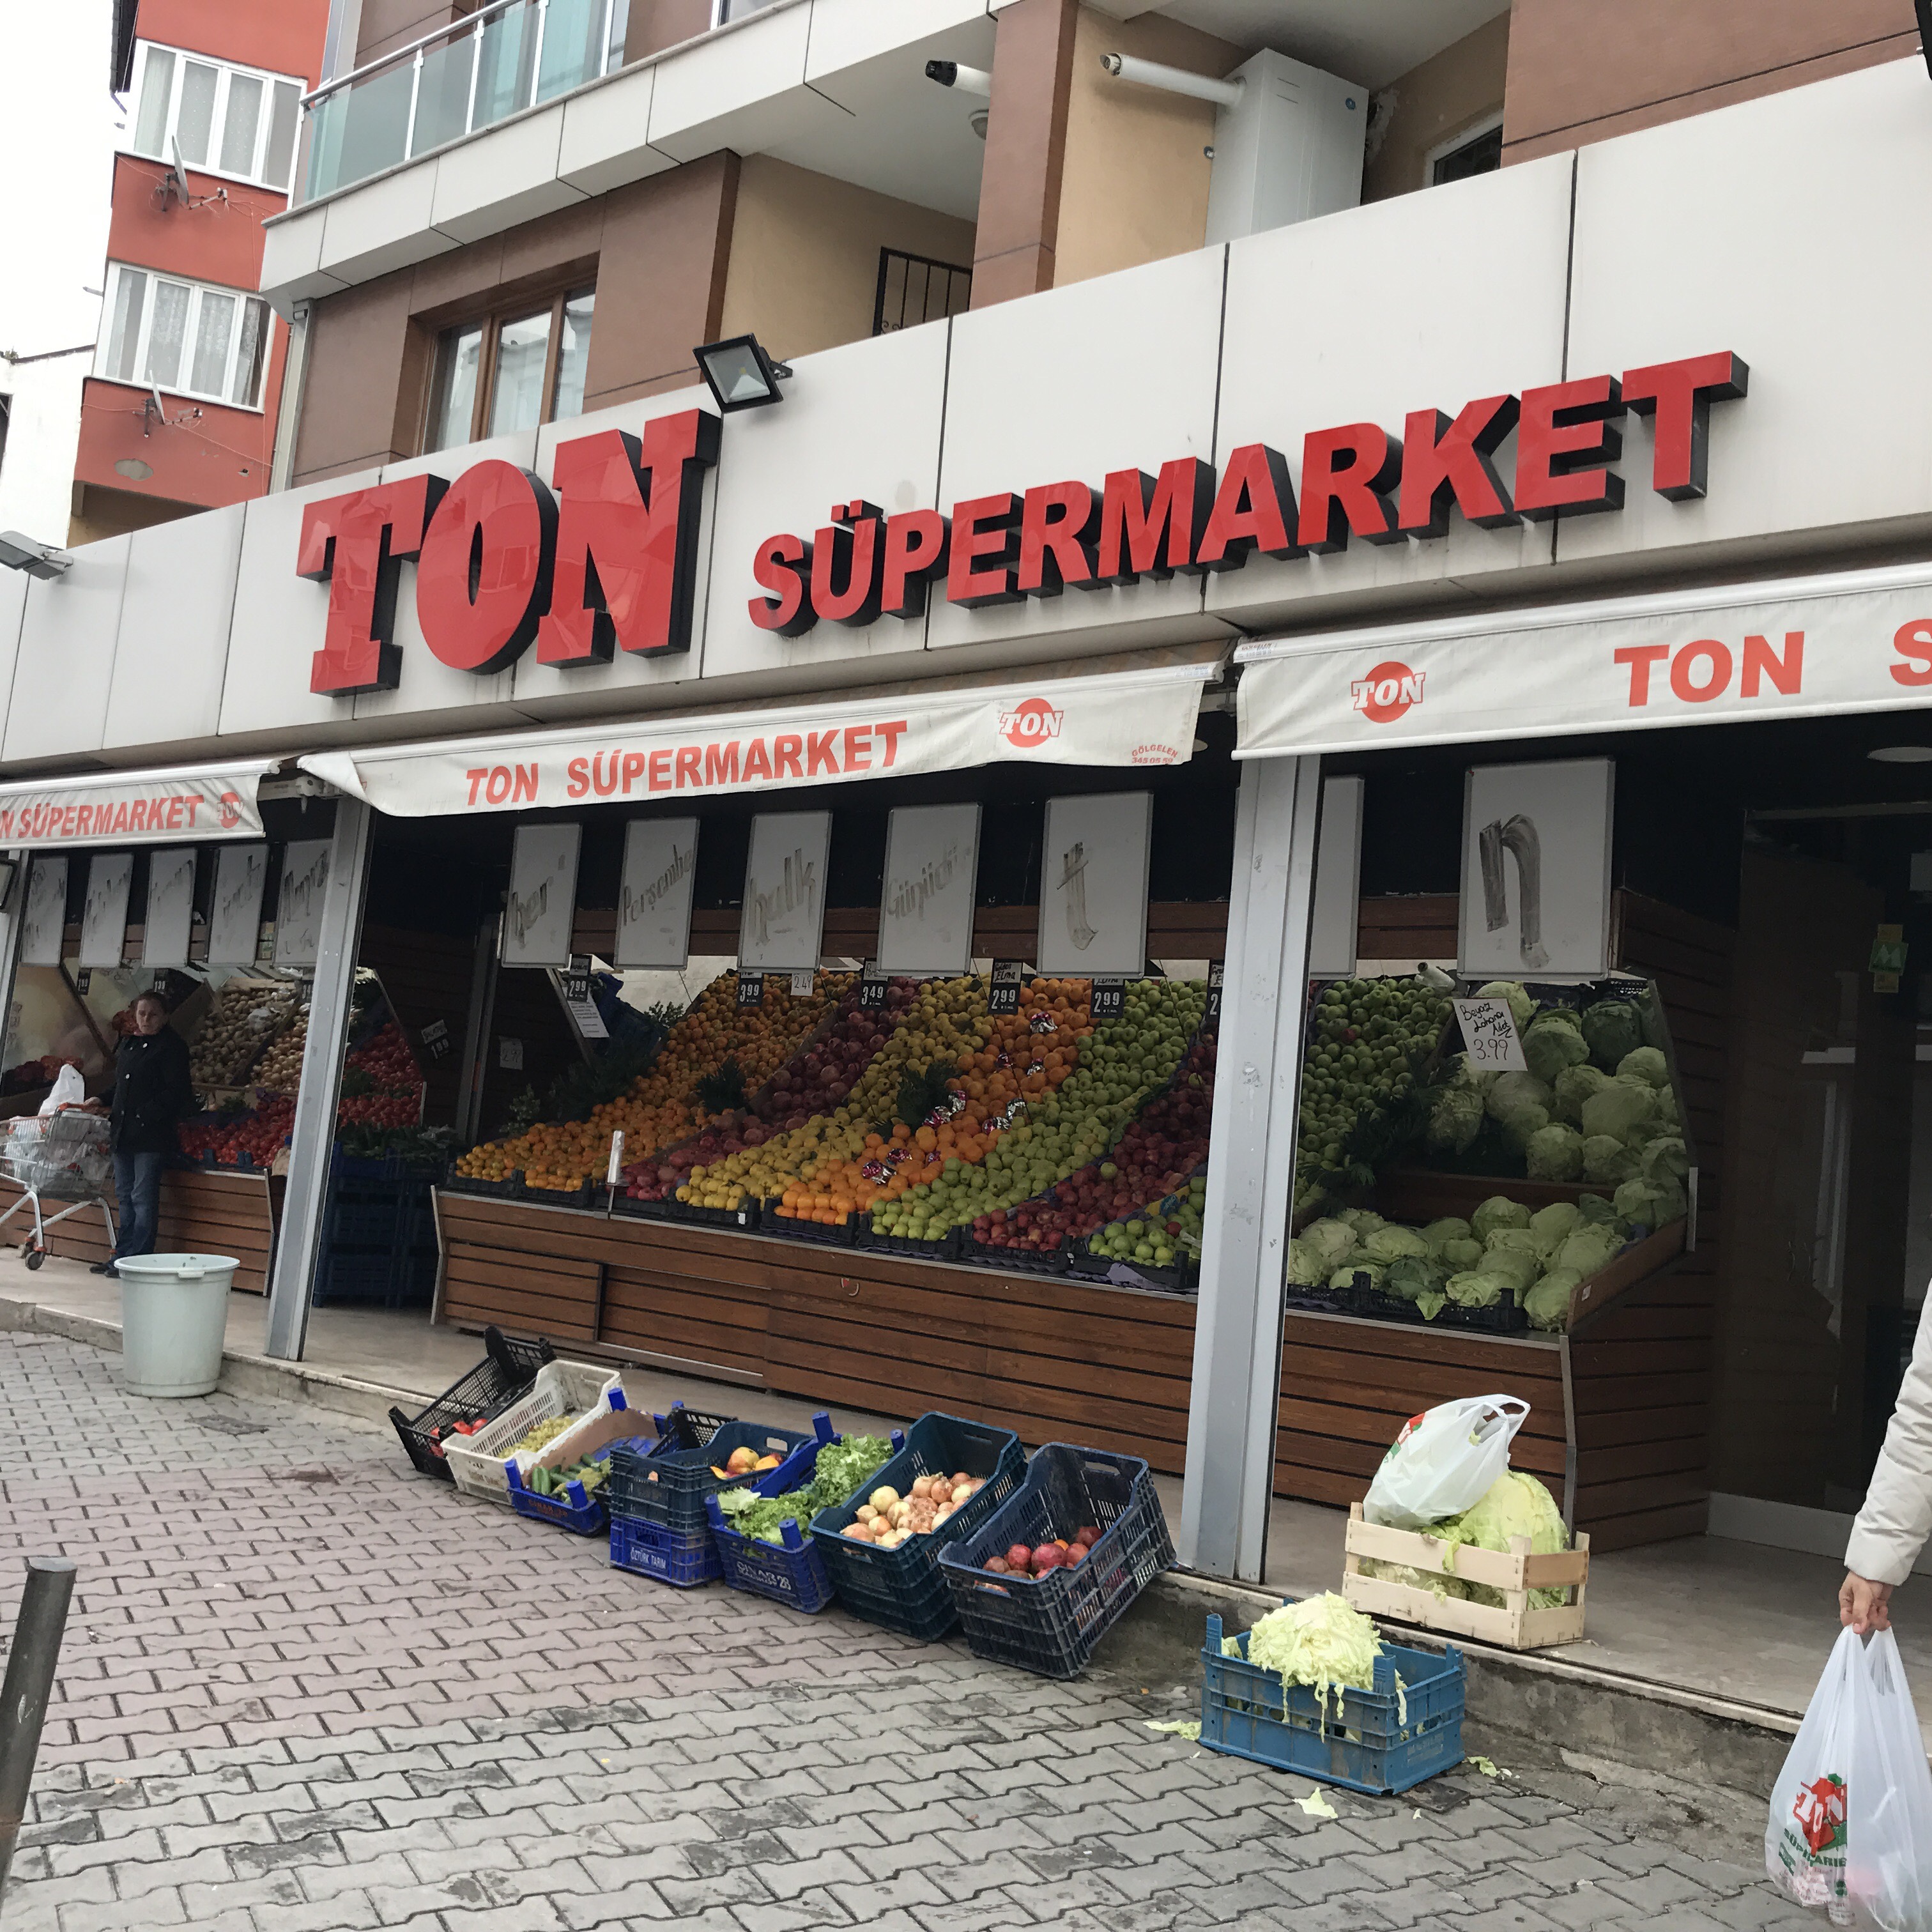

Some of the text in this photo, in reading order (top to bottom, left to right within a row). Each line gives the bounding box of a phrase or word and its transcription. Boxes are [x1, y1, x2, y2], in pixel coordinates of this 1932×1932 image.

[296, 350, 1749, 698] TON SÜPERMARKET
[1613, 631, 1805, 707] TON
[1351, 671, 1426, 710] TON
[999, 710, 1063, 738] TON
[466, 720, 907, 806] TON SÜPERMARKET
[1131, 744, 1178, 758] GÖLGELEN
[18, 794, 204, 839] SÜPERMARKET
[995, 971, 1016, 982] Elma
[1460, 1002, 1494, 1021] Beyaz
[1473, 1039, 1508, 1061] 3.99
